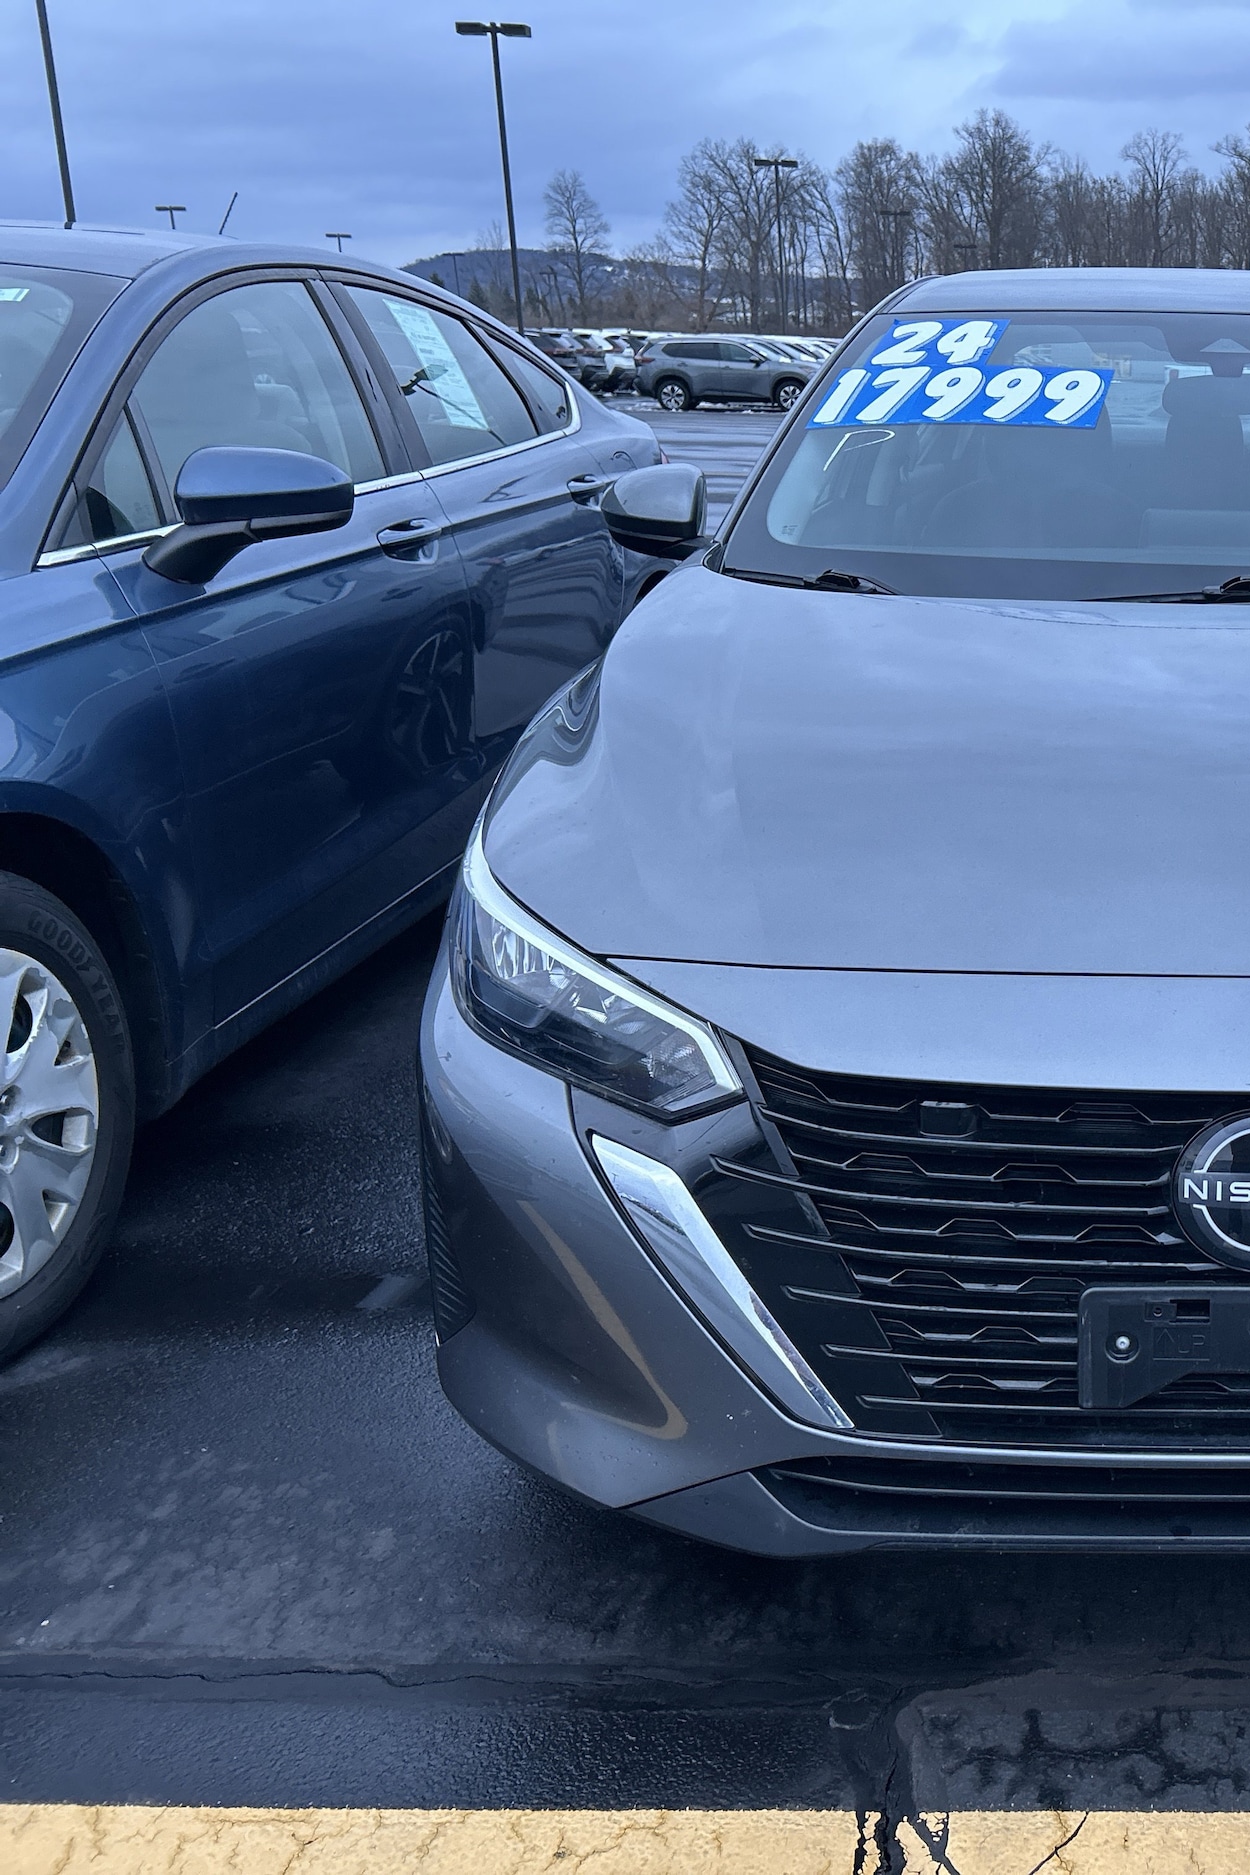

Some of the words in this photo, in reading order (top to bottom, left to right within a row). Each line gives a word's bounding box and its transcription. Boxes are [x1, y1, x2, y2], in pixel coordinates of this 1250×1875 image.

[870, 320, 999, 366] 24
[812, 365, 1106, 425] 17999
[1177, 1333, 1206, 1354] UP
